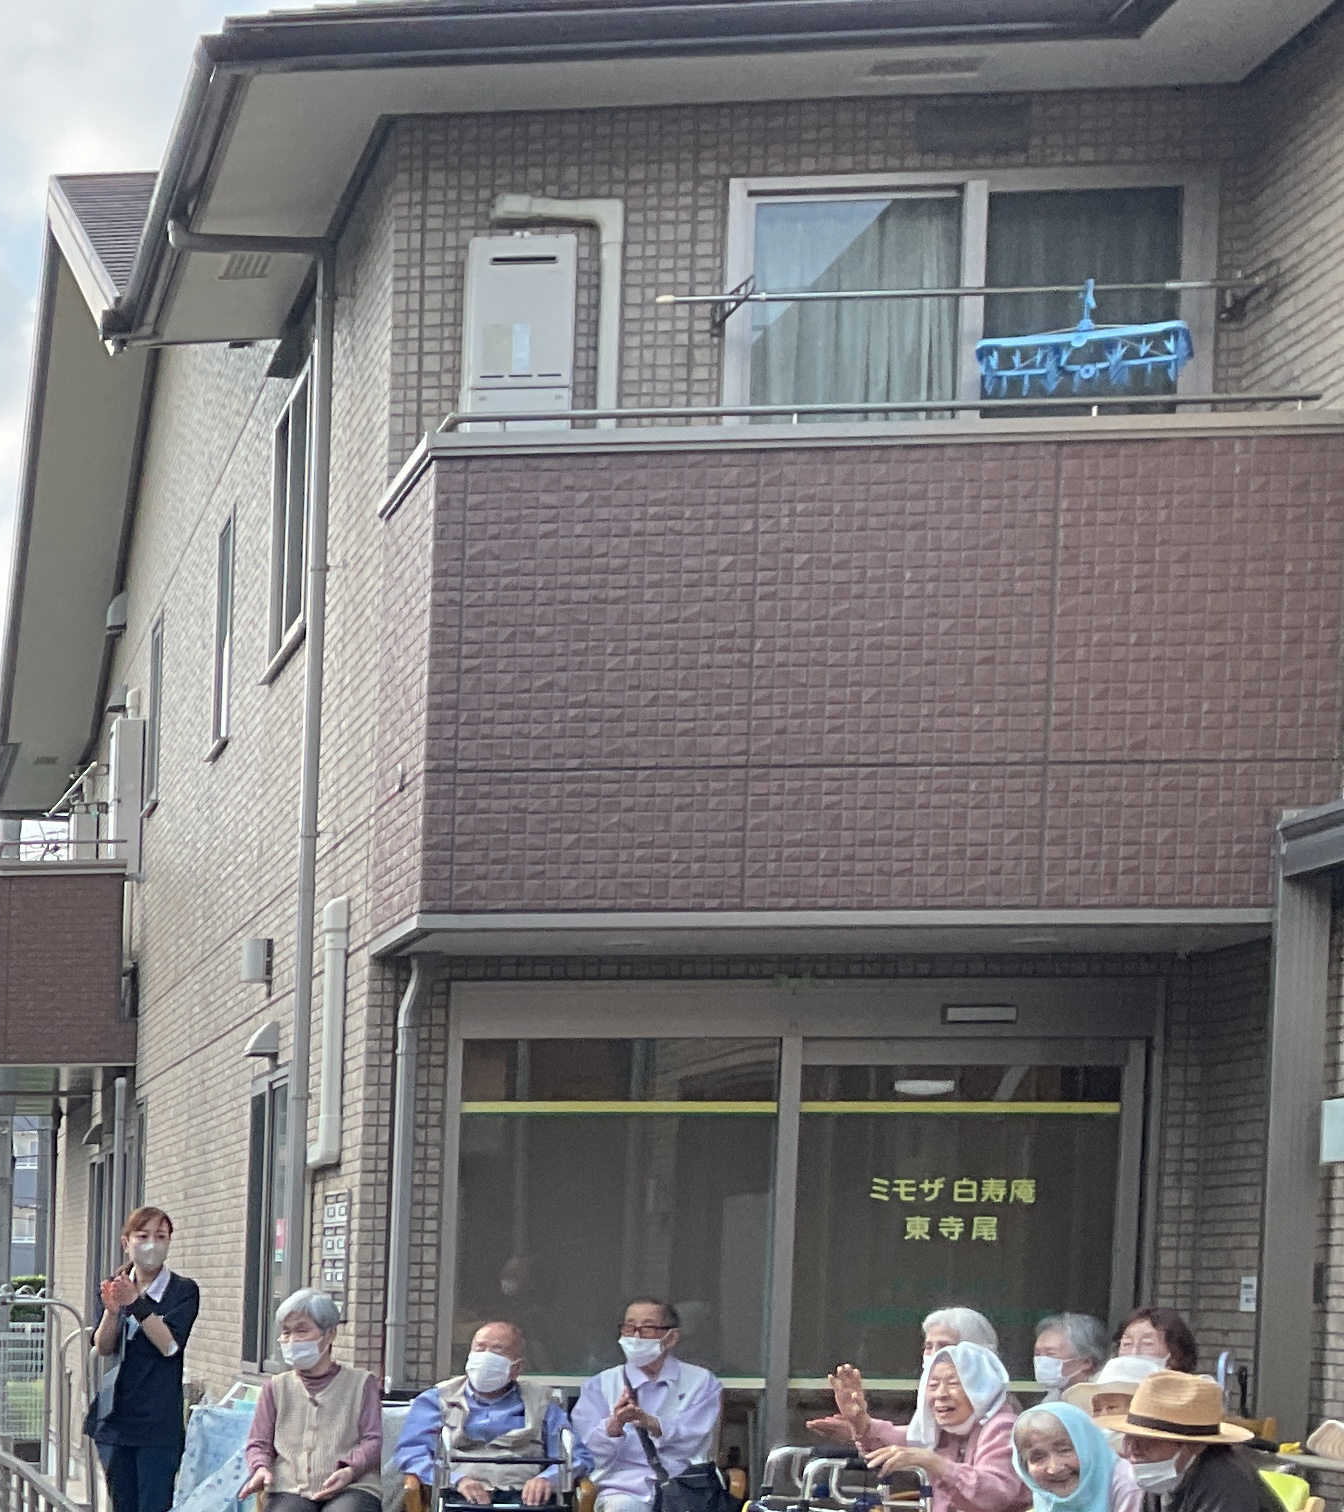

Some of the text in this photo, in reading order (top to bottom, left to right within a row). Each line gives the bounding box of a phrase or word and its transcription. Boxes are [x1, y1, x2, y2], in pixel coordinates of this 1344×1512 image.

[869, 1177, 1037, 1204] ミモザ 白寿庵
[903, 1216, 998, 1242] 東寺尾
